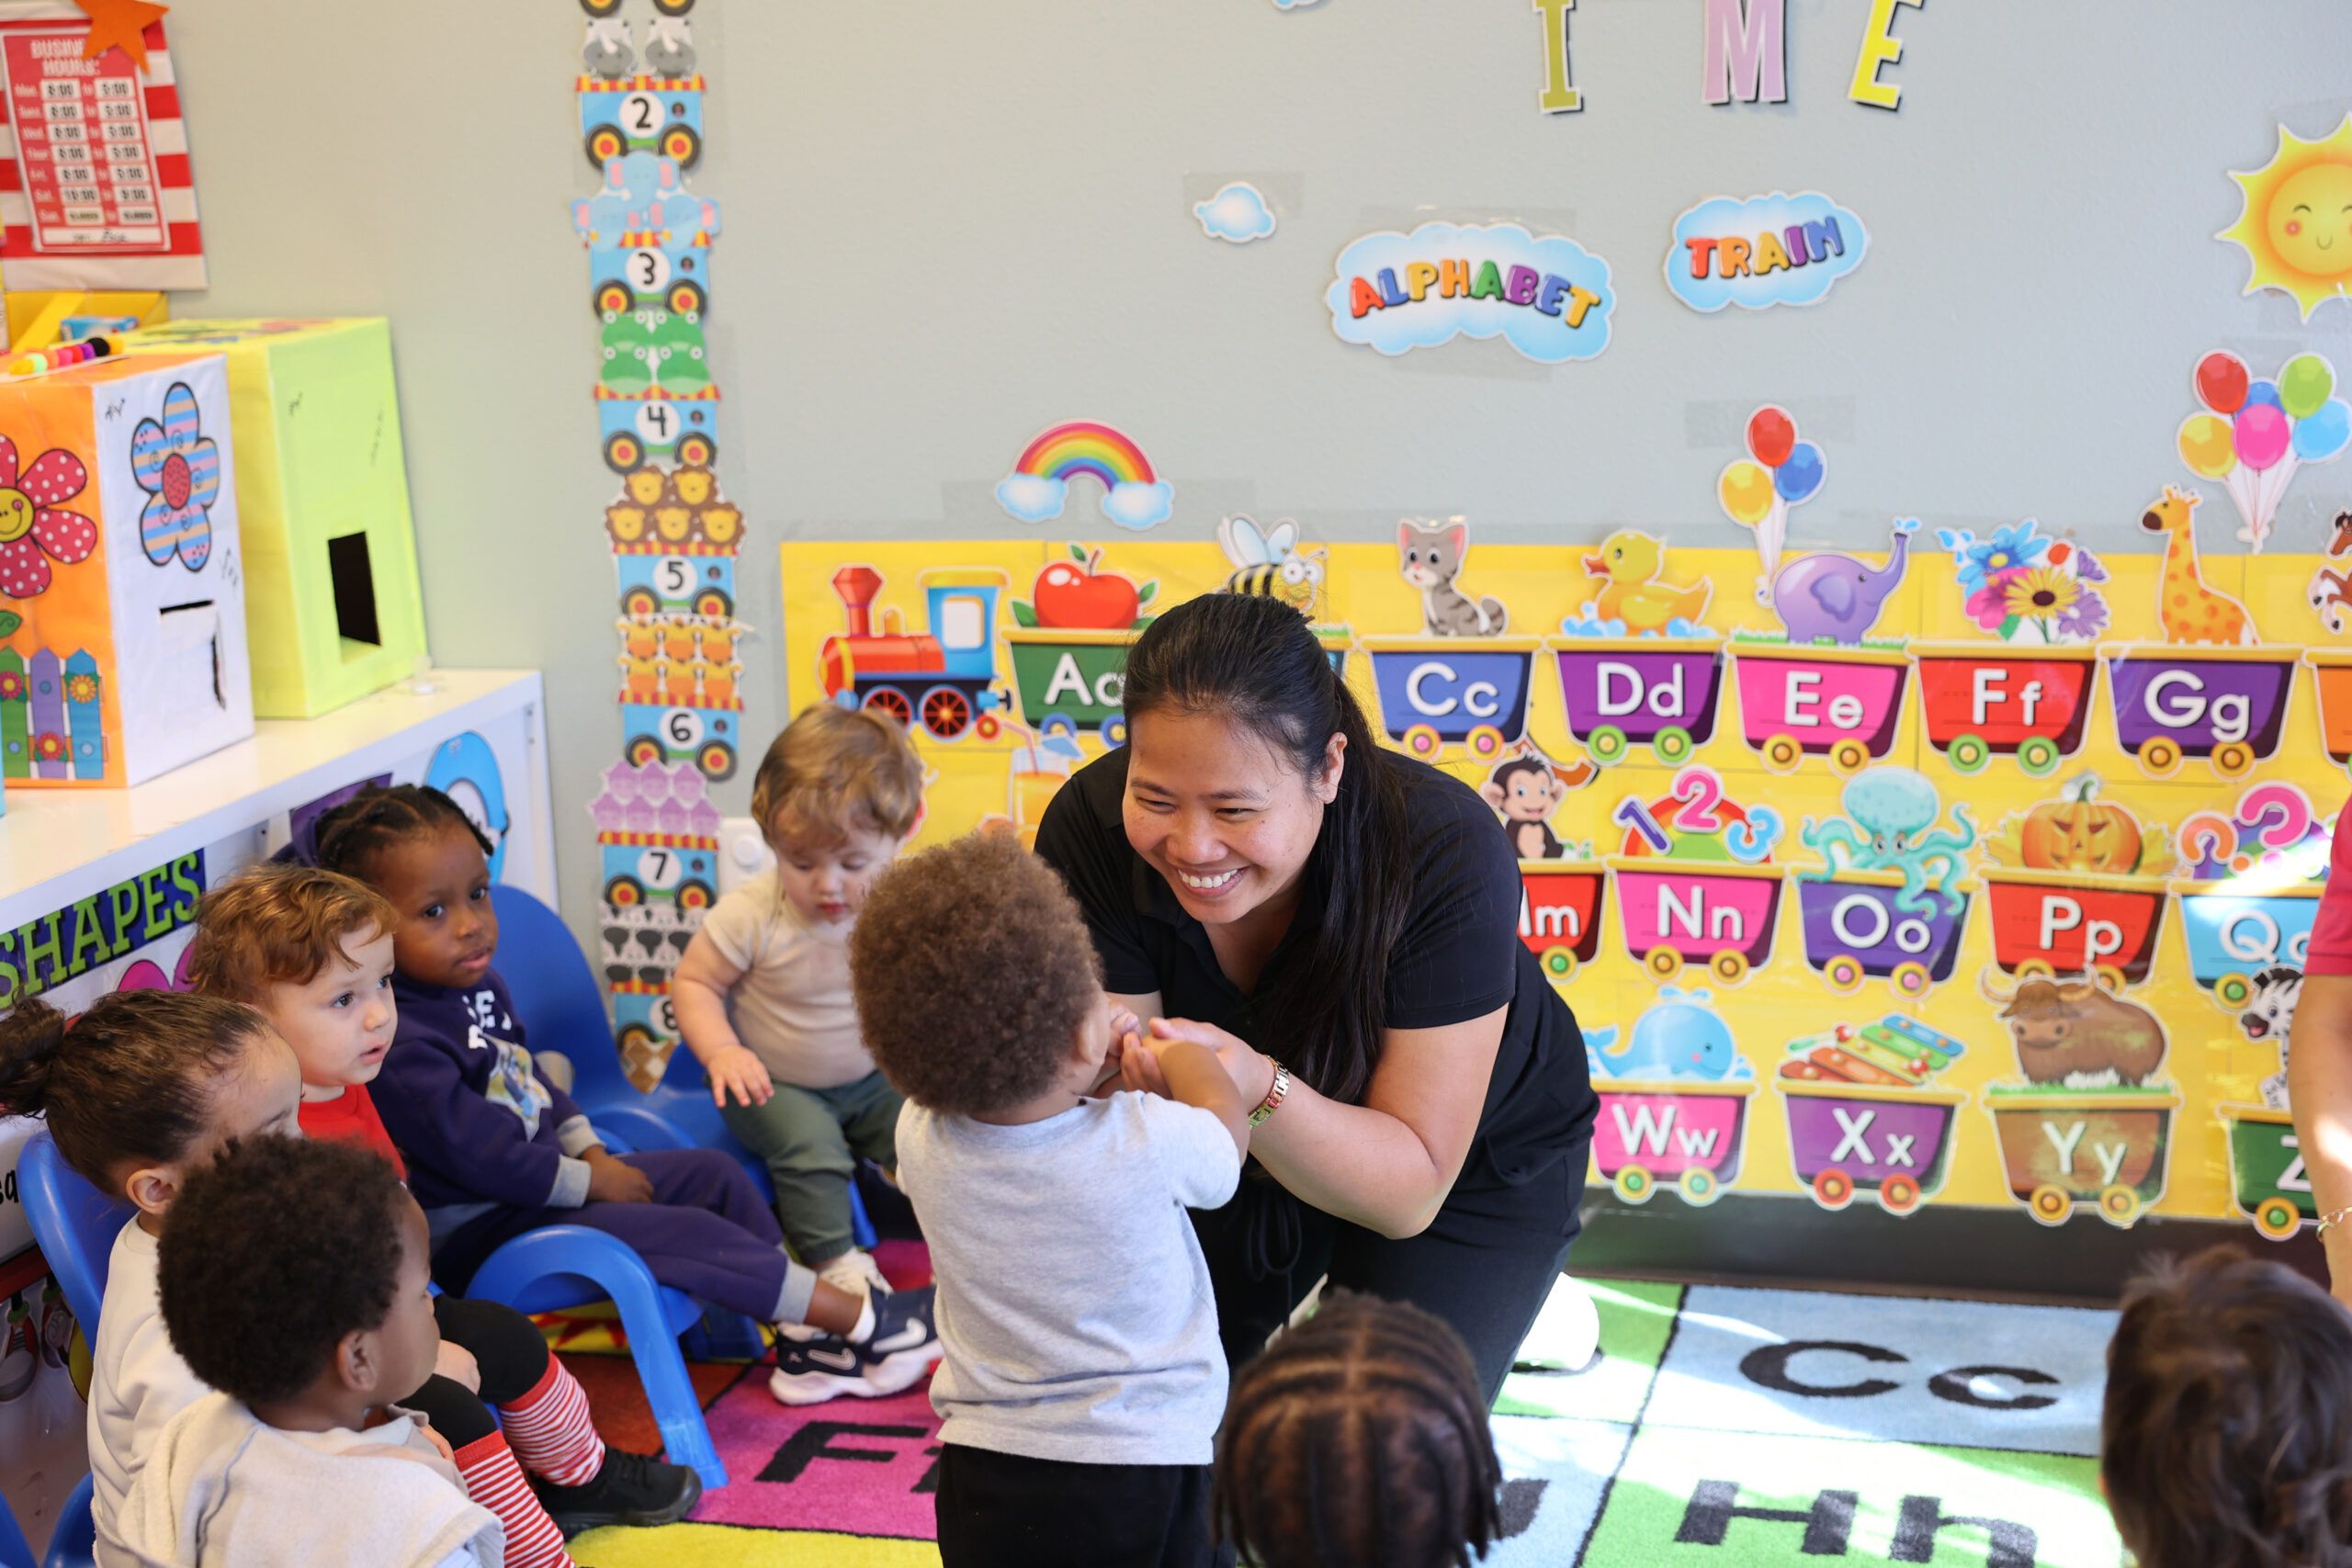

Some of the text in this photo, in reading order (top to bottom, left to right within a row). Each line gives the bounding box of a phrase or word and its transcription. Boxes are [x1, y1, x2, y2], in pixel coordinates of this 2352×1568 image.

[632, 96, 652, 130] 2
[637, 252, 657, 286] 3
[1686, 217, 1845, 279] TRAIN
[1350, 258, 1600, 329] ALPHABET
[646, 405, 667, 437] 4
[666, 561, 684, 591] 5
[670, 714, 692, 742] 6
[1406, 662, 1499, 717] Cc
[1596, 662, 1684, 717] Dd
[1783, 671, 1864, 729] Ee
[1972, 668, 2042, 726] Ff
[2143, 670, 2251, 742] Gg
[649, 852, 669, 882] 7
[0, 852, 202, 1009] SHAPES
[1519, 885, 1578, 937] m
[1657, 884, 1743, 941] Nn
[1831, 894, 1930, 953] Oo
[2039, 896, 2122, 962] Pp
[1611, 1103, 1719, 1158] Ww
[1831, 1108, 1917, 1168] Xx
[2041, 1121, 2125, 1186] Yy
[1739, 1340, 2063, 1410] Cc
[1675, 1479, 2039, 1568] Hh
